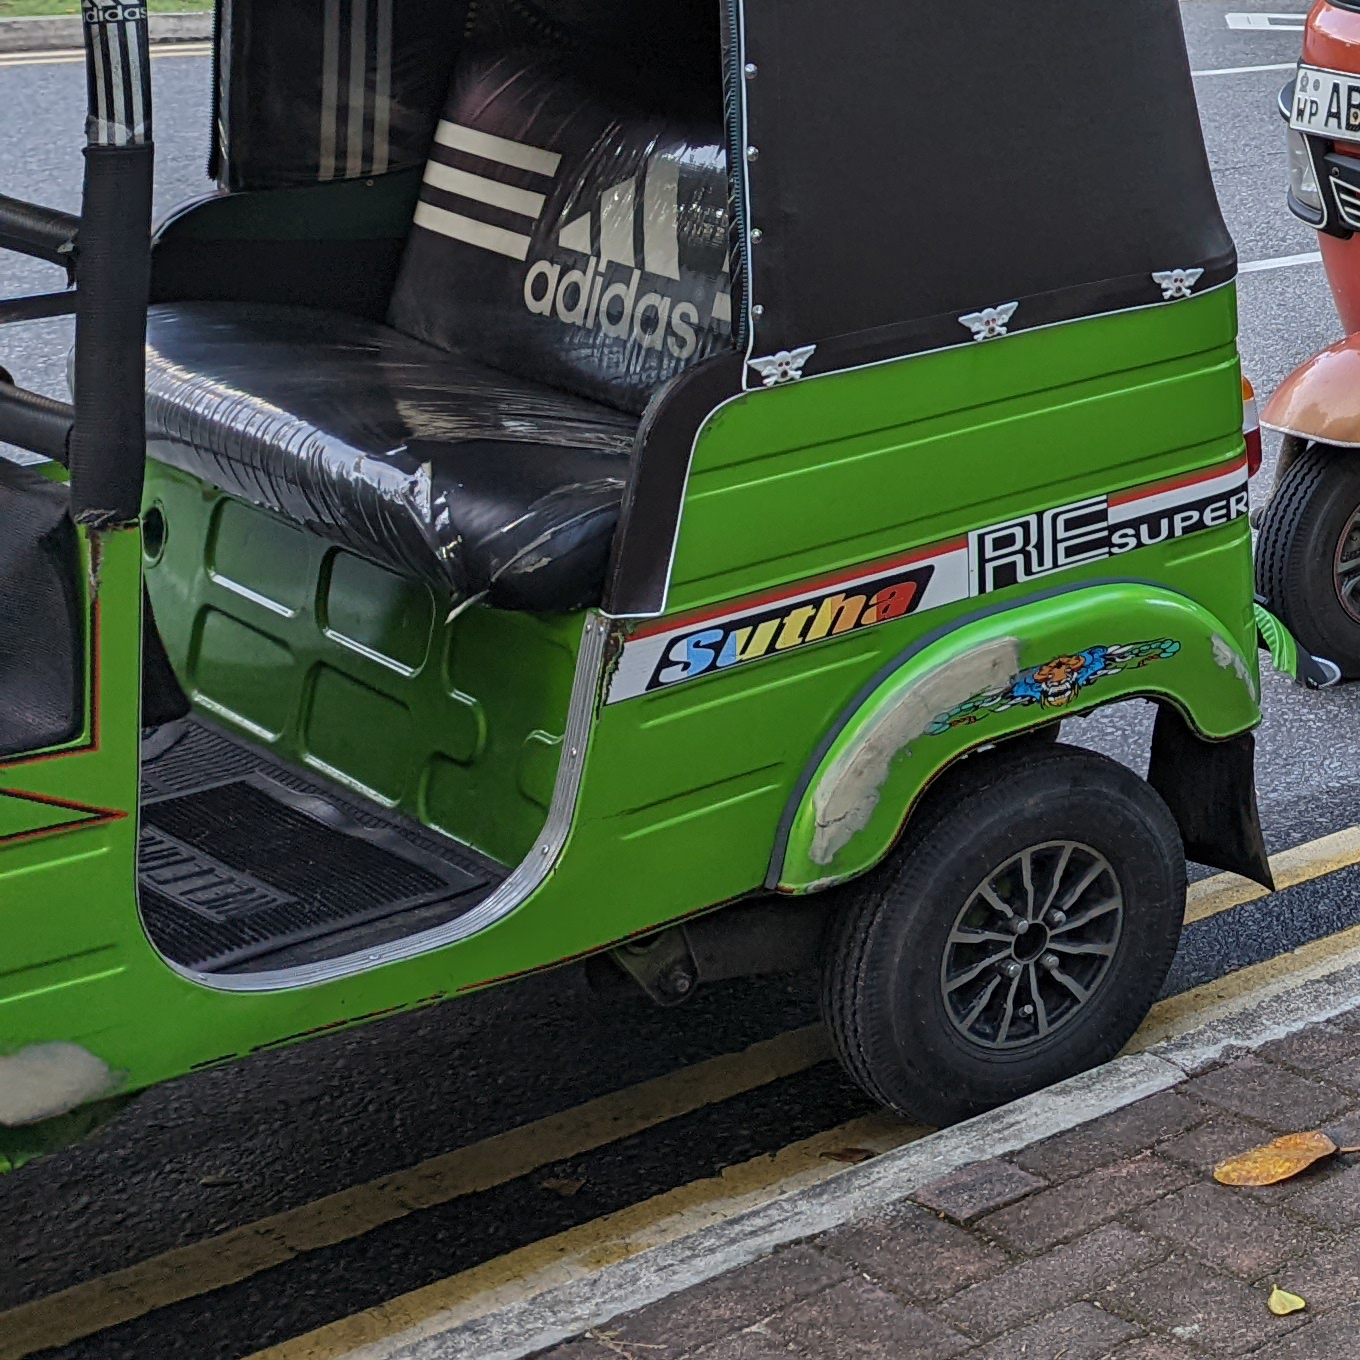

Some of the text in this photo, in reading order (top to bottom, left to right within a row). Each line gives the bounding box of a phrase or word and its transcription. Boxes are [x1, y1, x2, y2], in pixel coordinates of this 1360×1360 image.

[82, 3, 148, 24] didas
[1295, 96, 1320, 125] WP
[523, 254, 700, 360] adidas
[967, 490, 1249, 598] RE SUPER
[658, 580, 918, 684] Sutha
